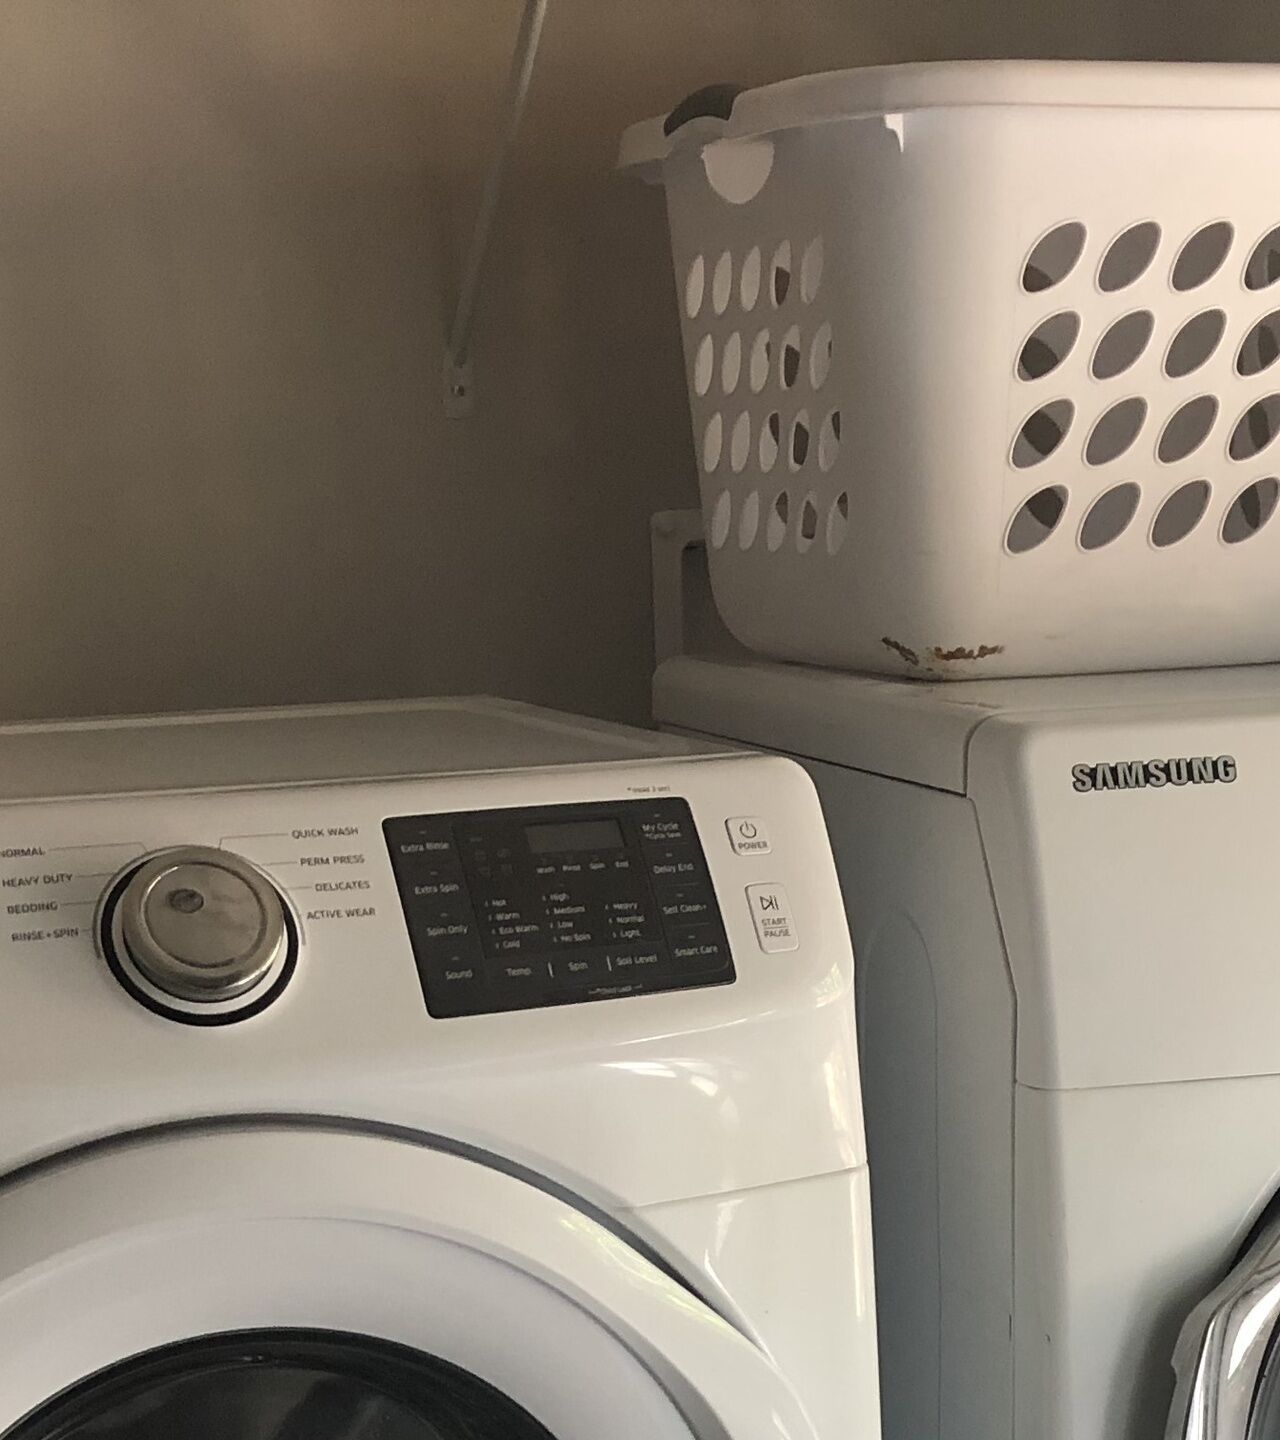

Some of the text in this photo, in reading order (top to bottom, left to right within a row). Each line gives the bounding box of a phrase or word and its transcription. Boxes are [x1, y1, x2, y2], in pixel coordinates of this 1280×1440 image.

[1071, 755, 1237, 792] SAMSUNG
[291, 827, 359, 839] QUICK WASH
[401, 844, 424, 853] Extra
[738, 841, 768, 850] POWER
[300, 854, 365, 866] PERM PRESS
[653, 863, 694, 874] Delay End
[2, 873, 72, 887] HEAVY DUTY
[315, 880, 370, 892] DELICATES
[415, 884, 460, 895] Extra Spin
[7, 901, 58, 914] BEDDING
[307, 907, 376, 919] ACTIVE WEAR
[496, 913, 520, 921] Warm
[762, 918, 786, 926] START
[11, 930, 45, 942] RINSE
[53, 927, 79, 938] SPIN
[427, 925, 468, 936] Spin Only
[515, 925, 539, 933] Warm
[620, 929, 641, 938] Light
[764, 929, 790, 938] PAUSE
[675, 945, 718, 957] Smart Care
[616, 954, 657, 966] Soil Level
[568, 962, 588, 971] Spin
[446, 970, 472, 980] Sound
